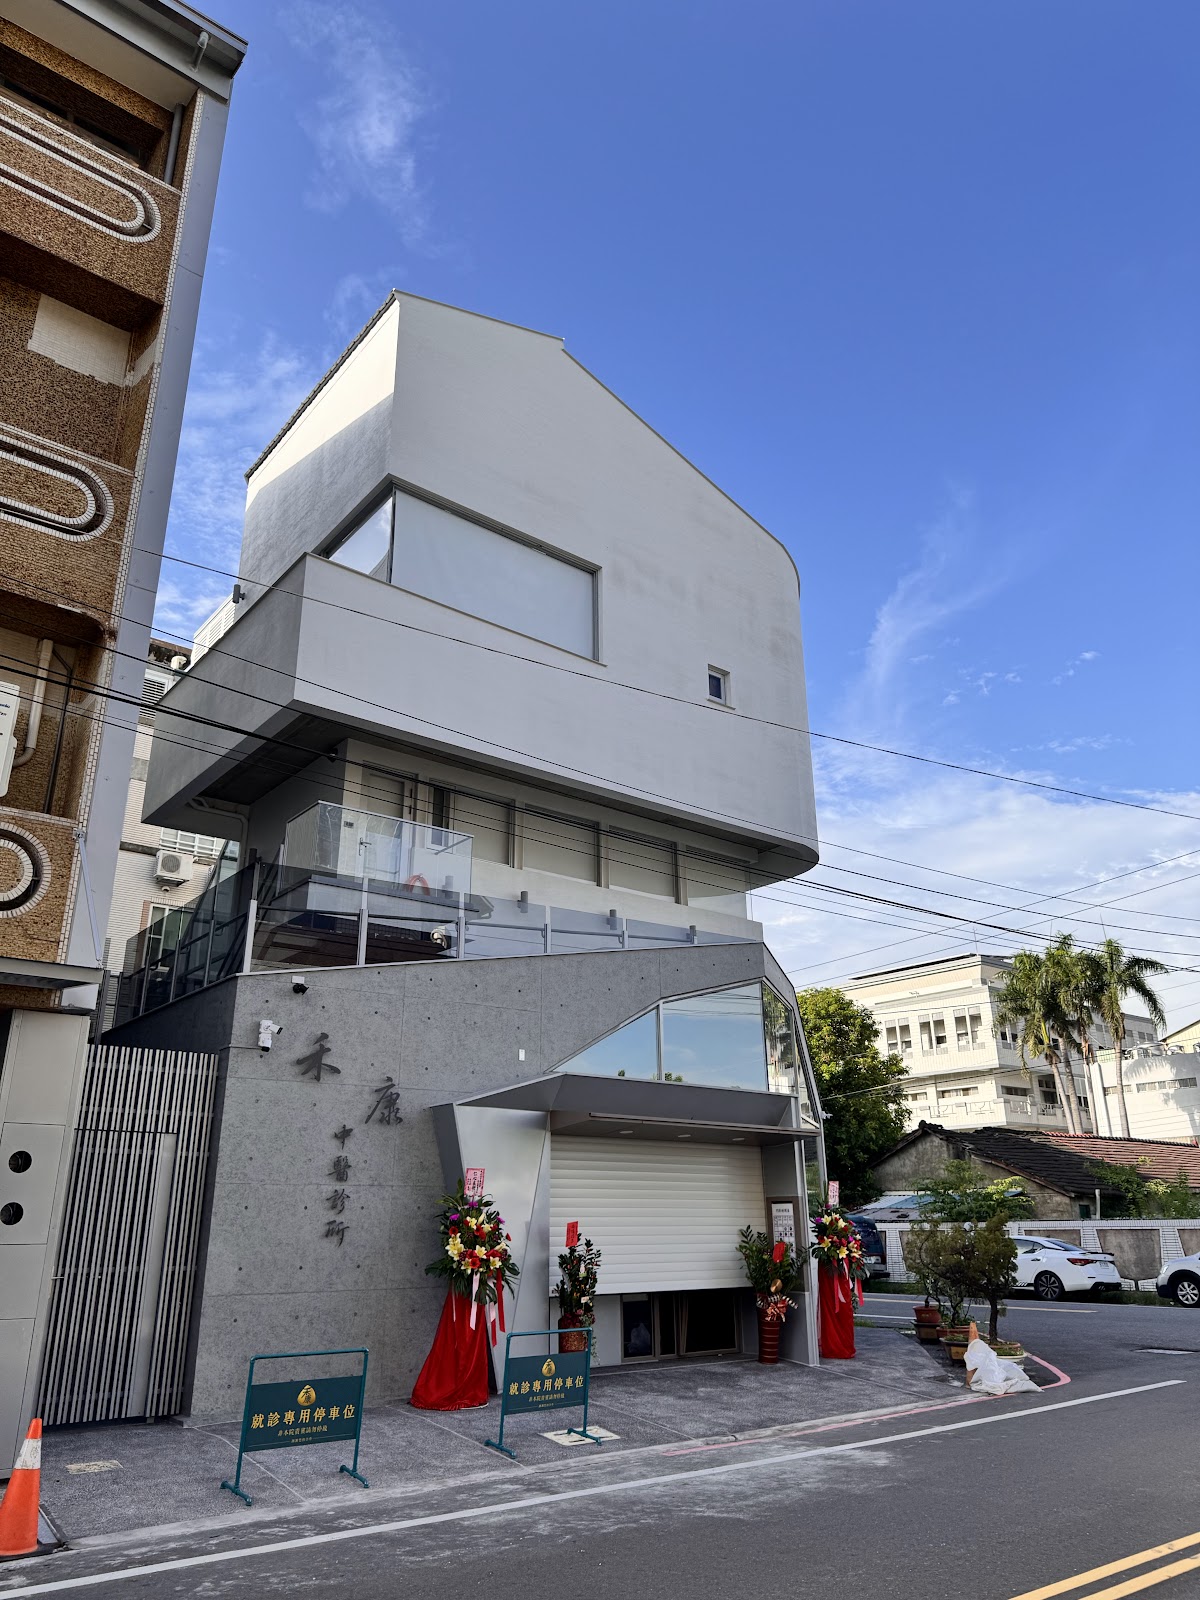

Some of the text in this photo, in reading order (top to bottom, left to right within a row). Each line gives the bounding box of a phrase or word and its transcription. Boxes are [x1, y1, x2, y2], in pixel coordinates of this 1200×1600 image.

[326, 1124, 353, 1247] 中醫診所
[509, 1376, 584, 1395] 就診專用停車位
[251, 1405, 355, 1429] 就診專用停車位
